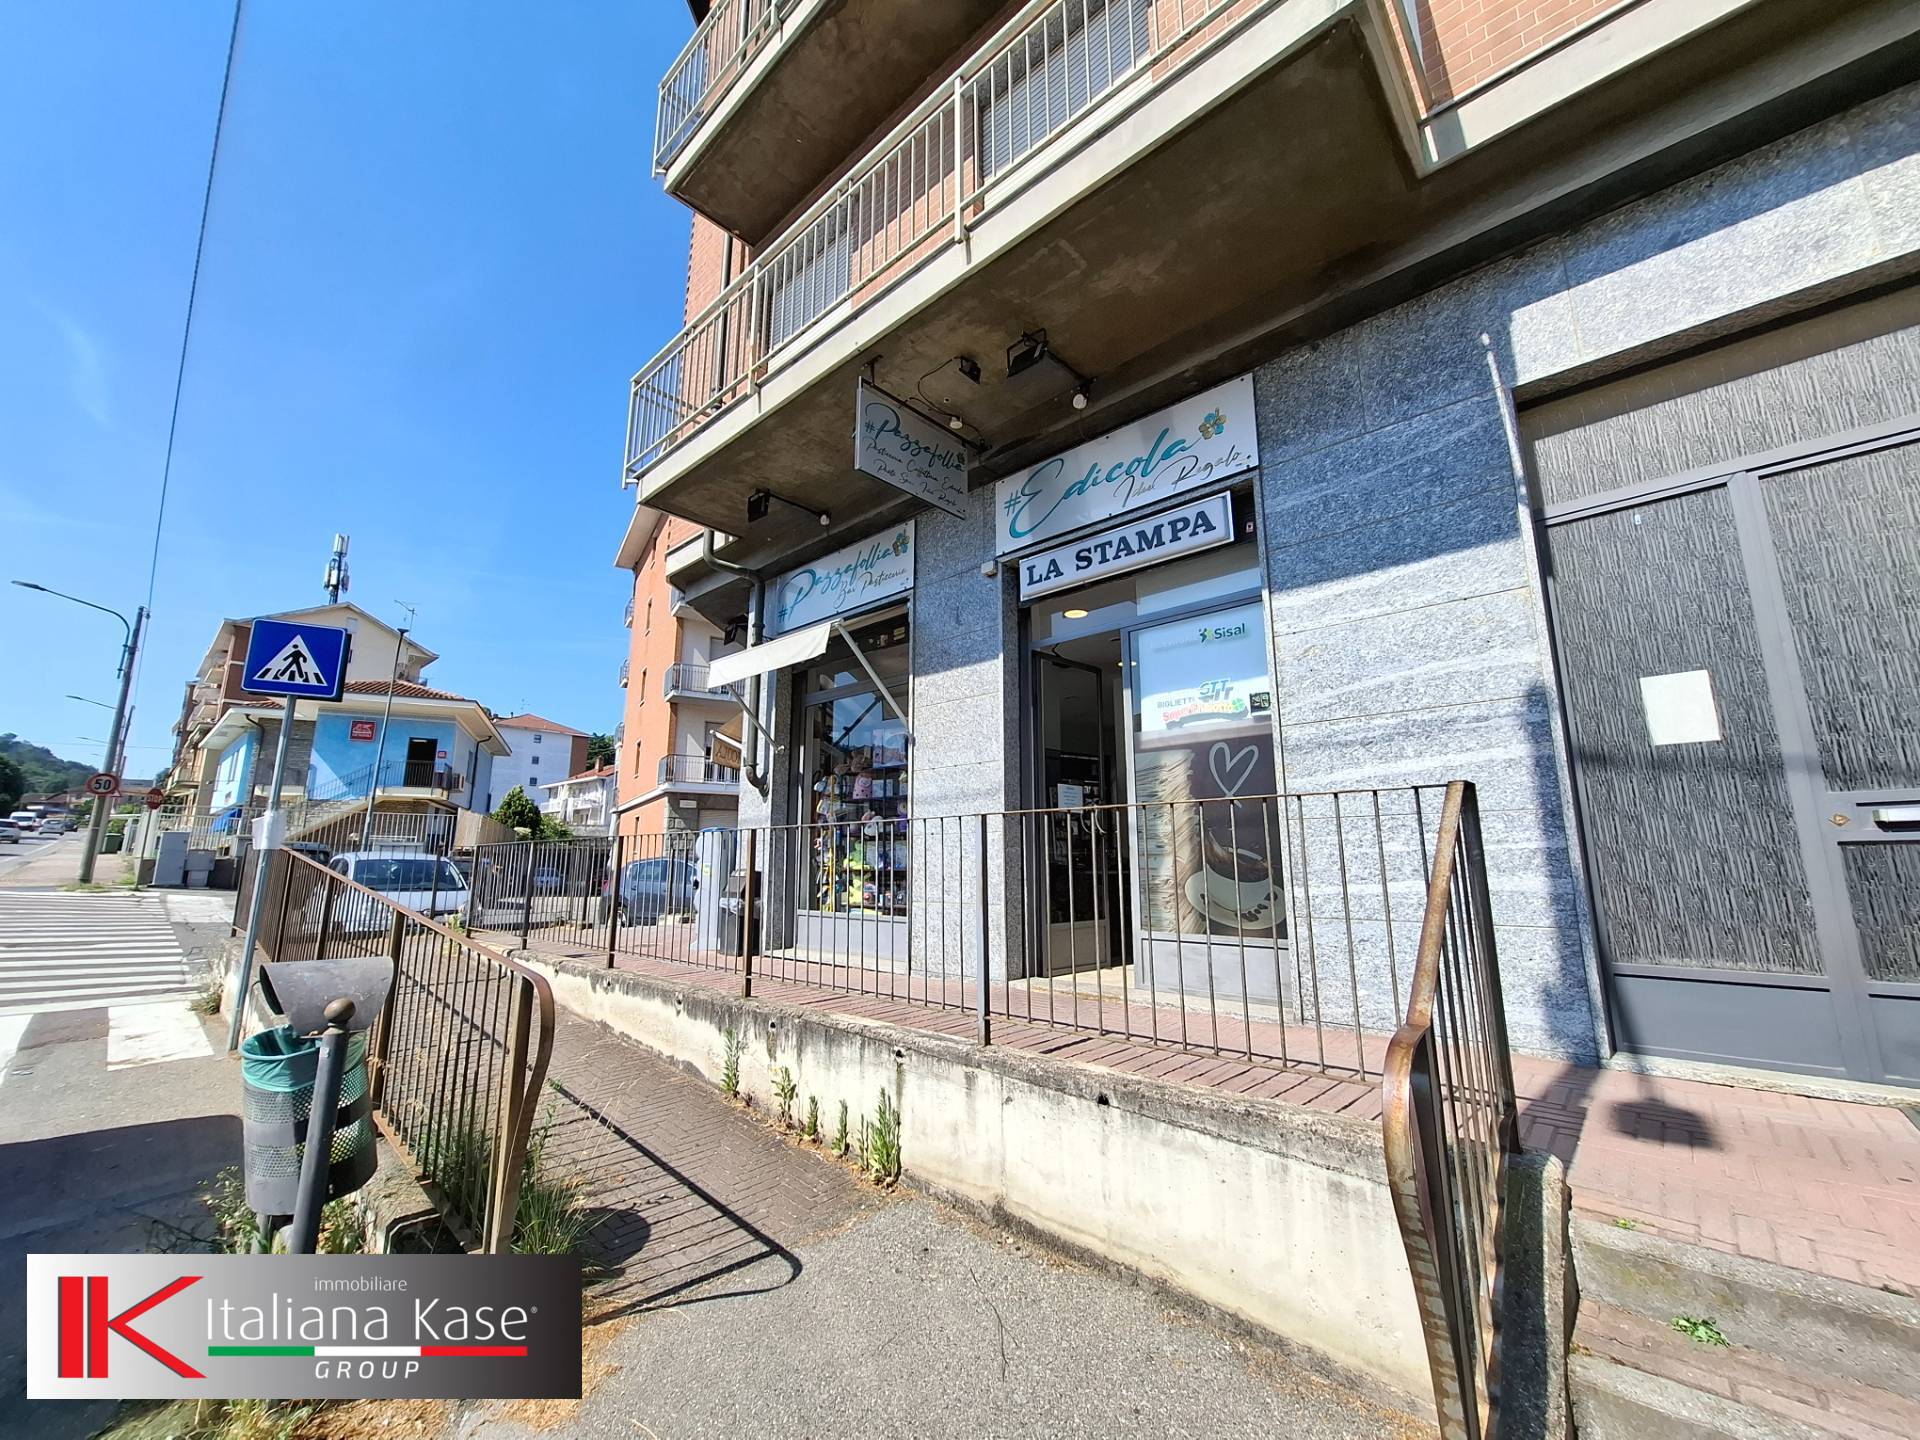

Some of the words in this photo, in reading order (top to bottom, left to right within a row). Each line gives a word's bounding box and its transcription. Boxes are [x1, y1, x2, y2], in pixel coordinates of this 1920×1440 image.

[1004, 428, 1197, 538] #Edicola
[1153, 445, 1240, 492] Regalo
[1027, 558, 1064, 587] LA
[1075, 510, 1217, 572] STAMPA
[777, 542, 894, 623] #Pazzafollia
[1214, 623, 1246, 640] Sisal
[95, 779, 112, 790] 50
